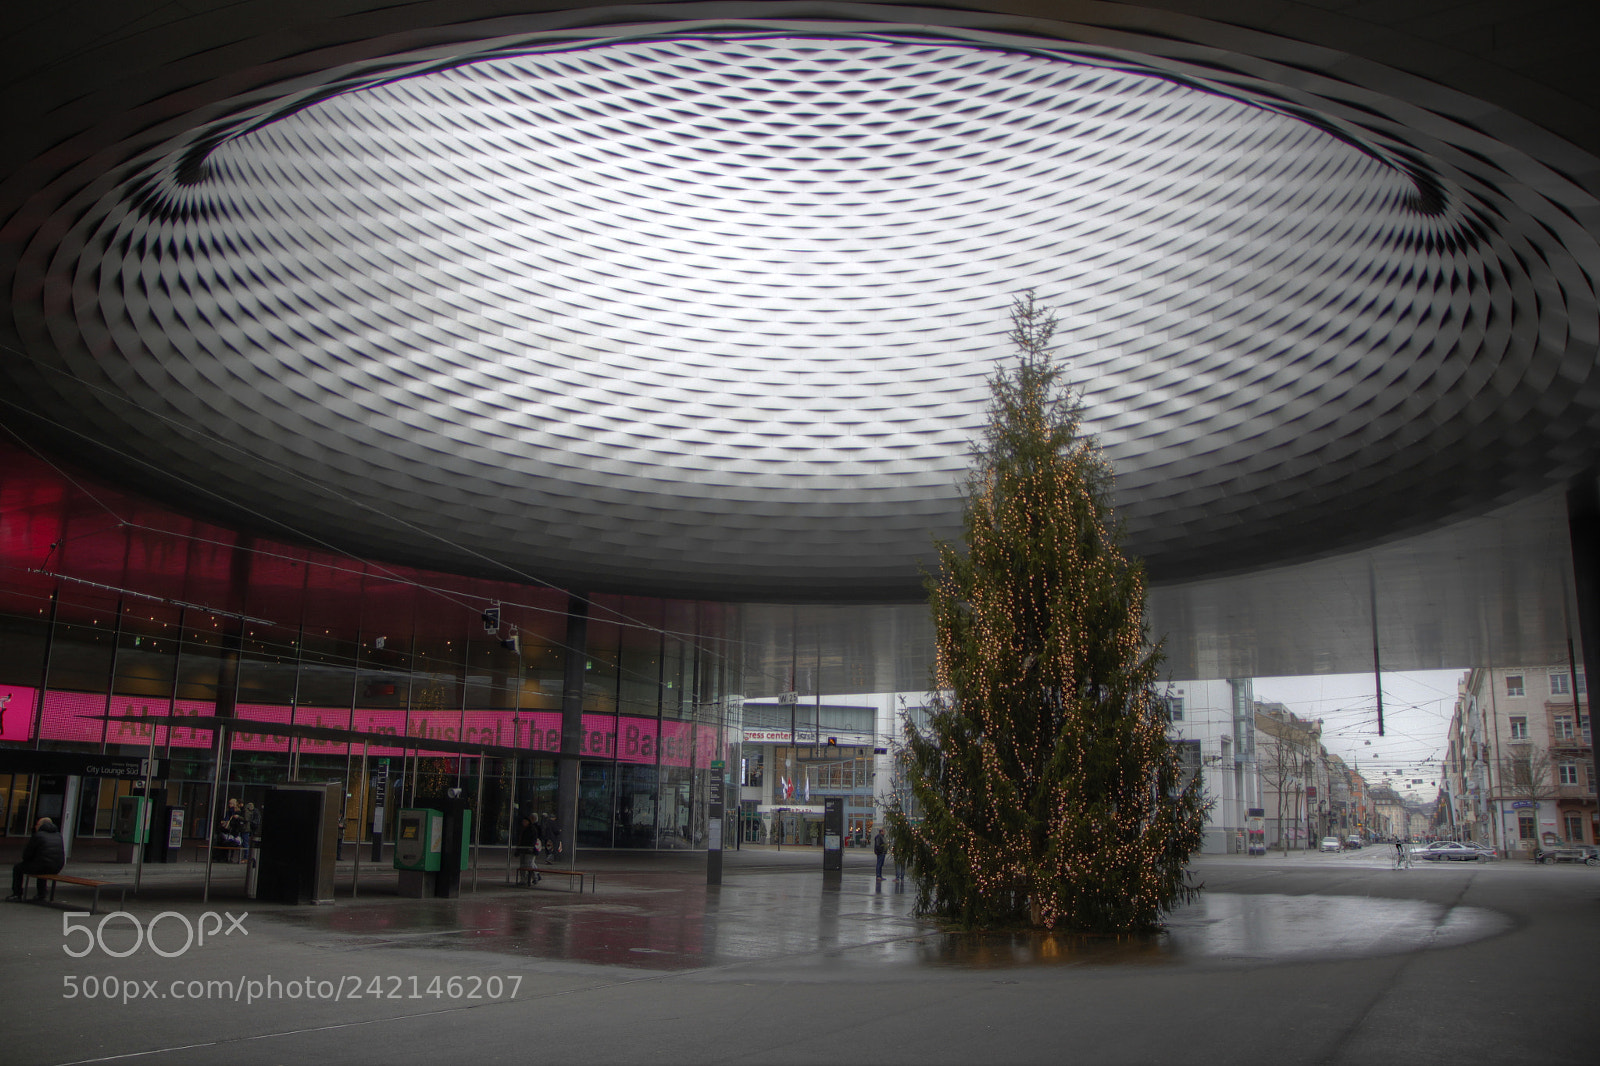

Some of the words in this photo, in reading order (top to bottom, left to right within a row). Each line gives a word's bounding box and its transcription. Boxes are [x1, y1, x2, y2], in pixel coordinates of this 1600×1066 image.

[408, 718, 502, 747] Muscal
[516, 719, 615, 753] Theter
[766, 731, 792, 739] center
[86, 764, 99, 775] City
[101, 766, 124, 776] Lounge
[126, 766, 139, 775] Süd
